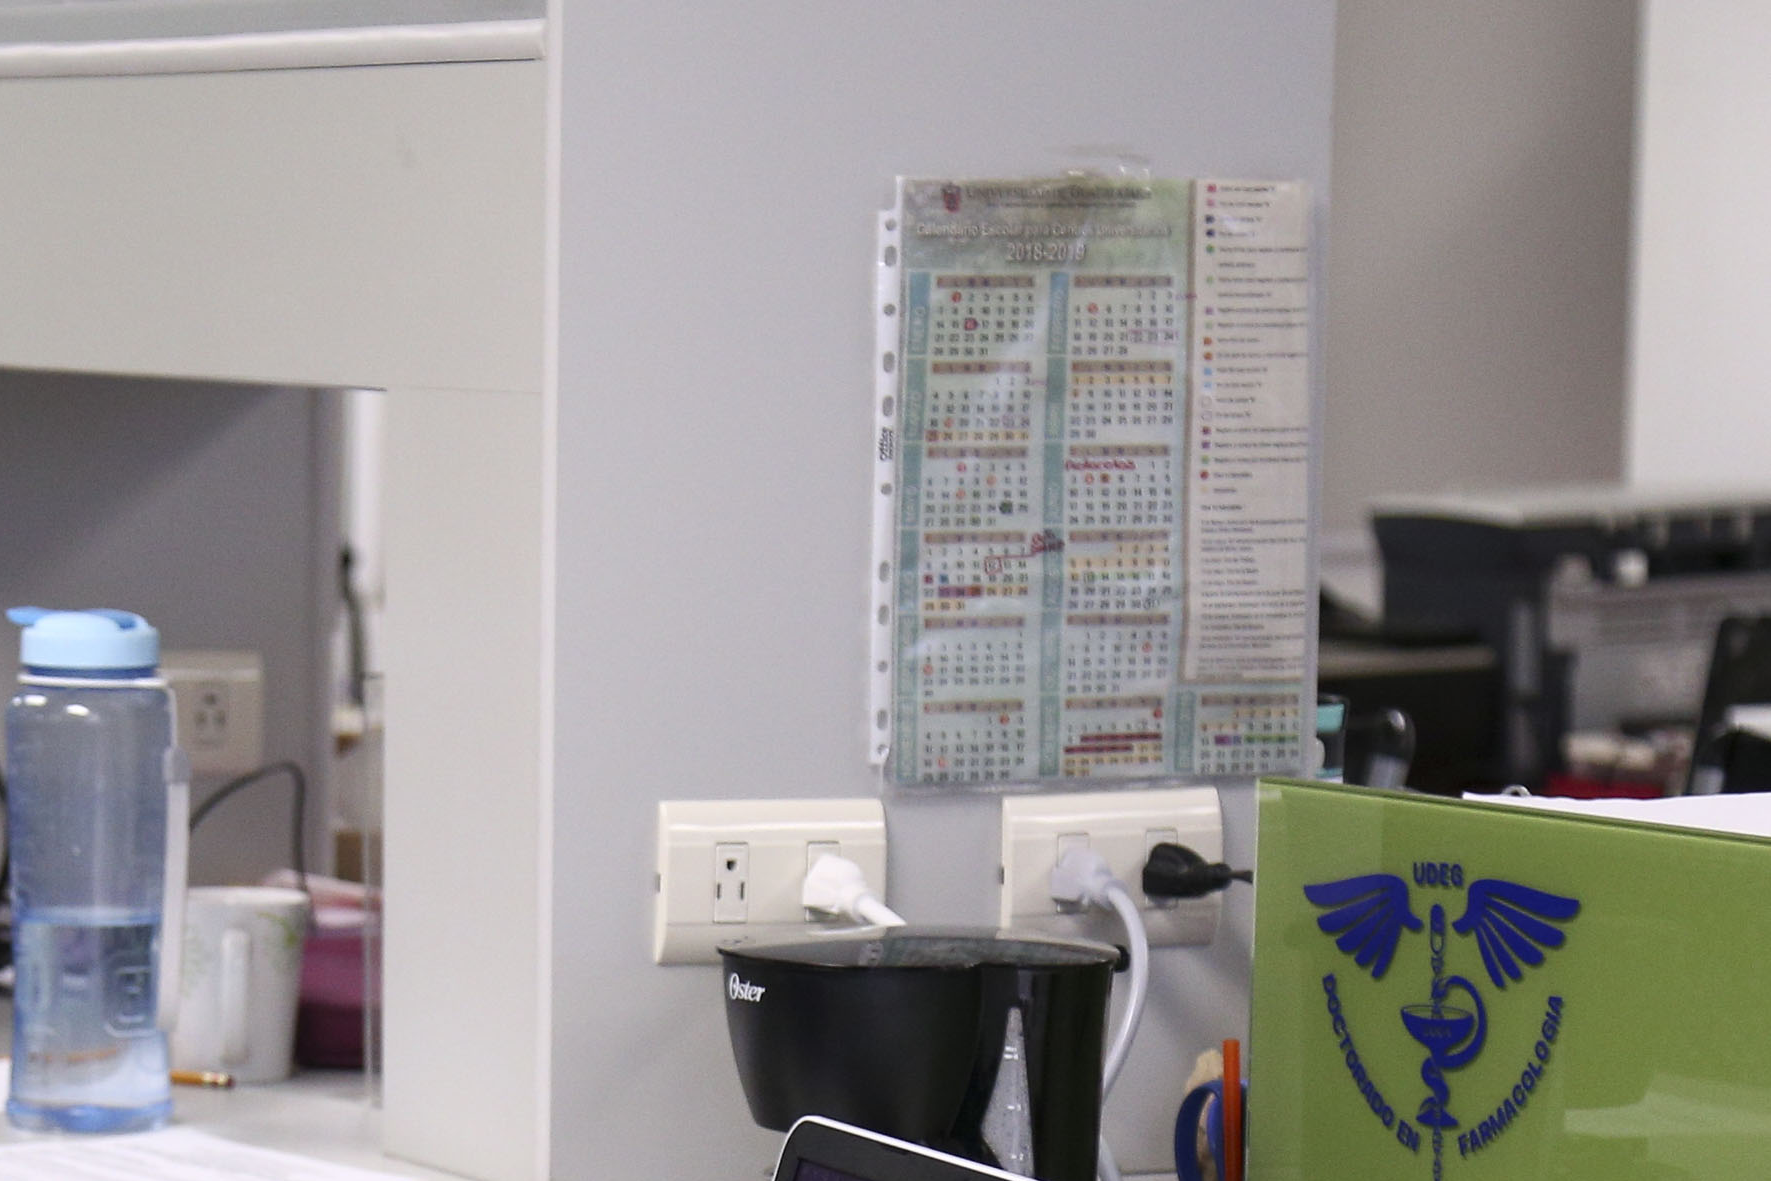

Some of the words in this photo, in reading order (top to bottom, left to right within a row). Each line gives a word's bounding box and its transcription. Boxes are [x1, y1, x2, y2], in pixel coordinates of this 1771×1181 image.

[1006, 243, 1086, 262] 2018-2019
[1413, 861, 1464, 887] UDEG
[730, 972, 766, 1002] Oster
[1323, 973, 1395, 1128] DOCTORADO
[1396, 1119, 1421, 1152] EN
[1457, 996, 1563, 1158] FARMACOLOGIA
